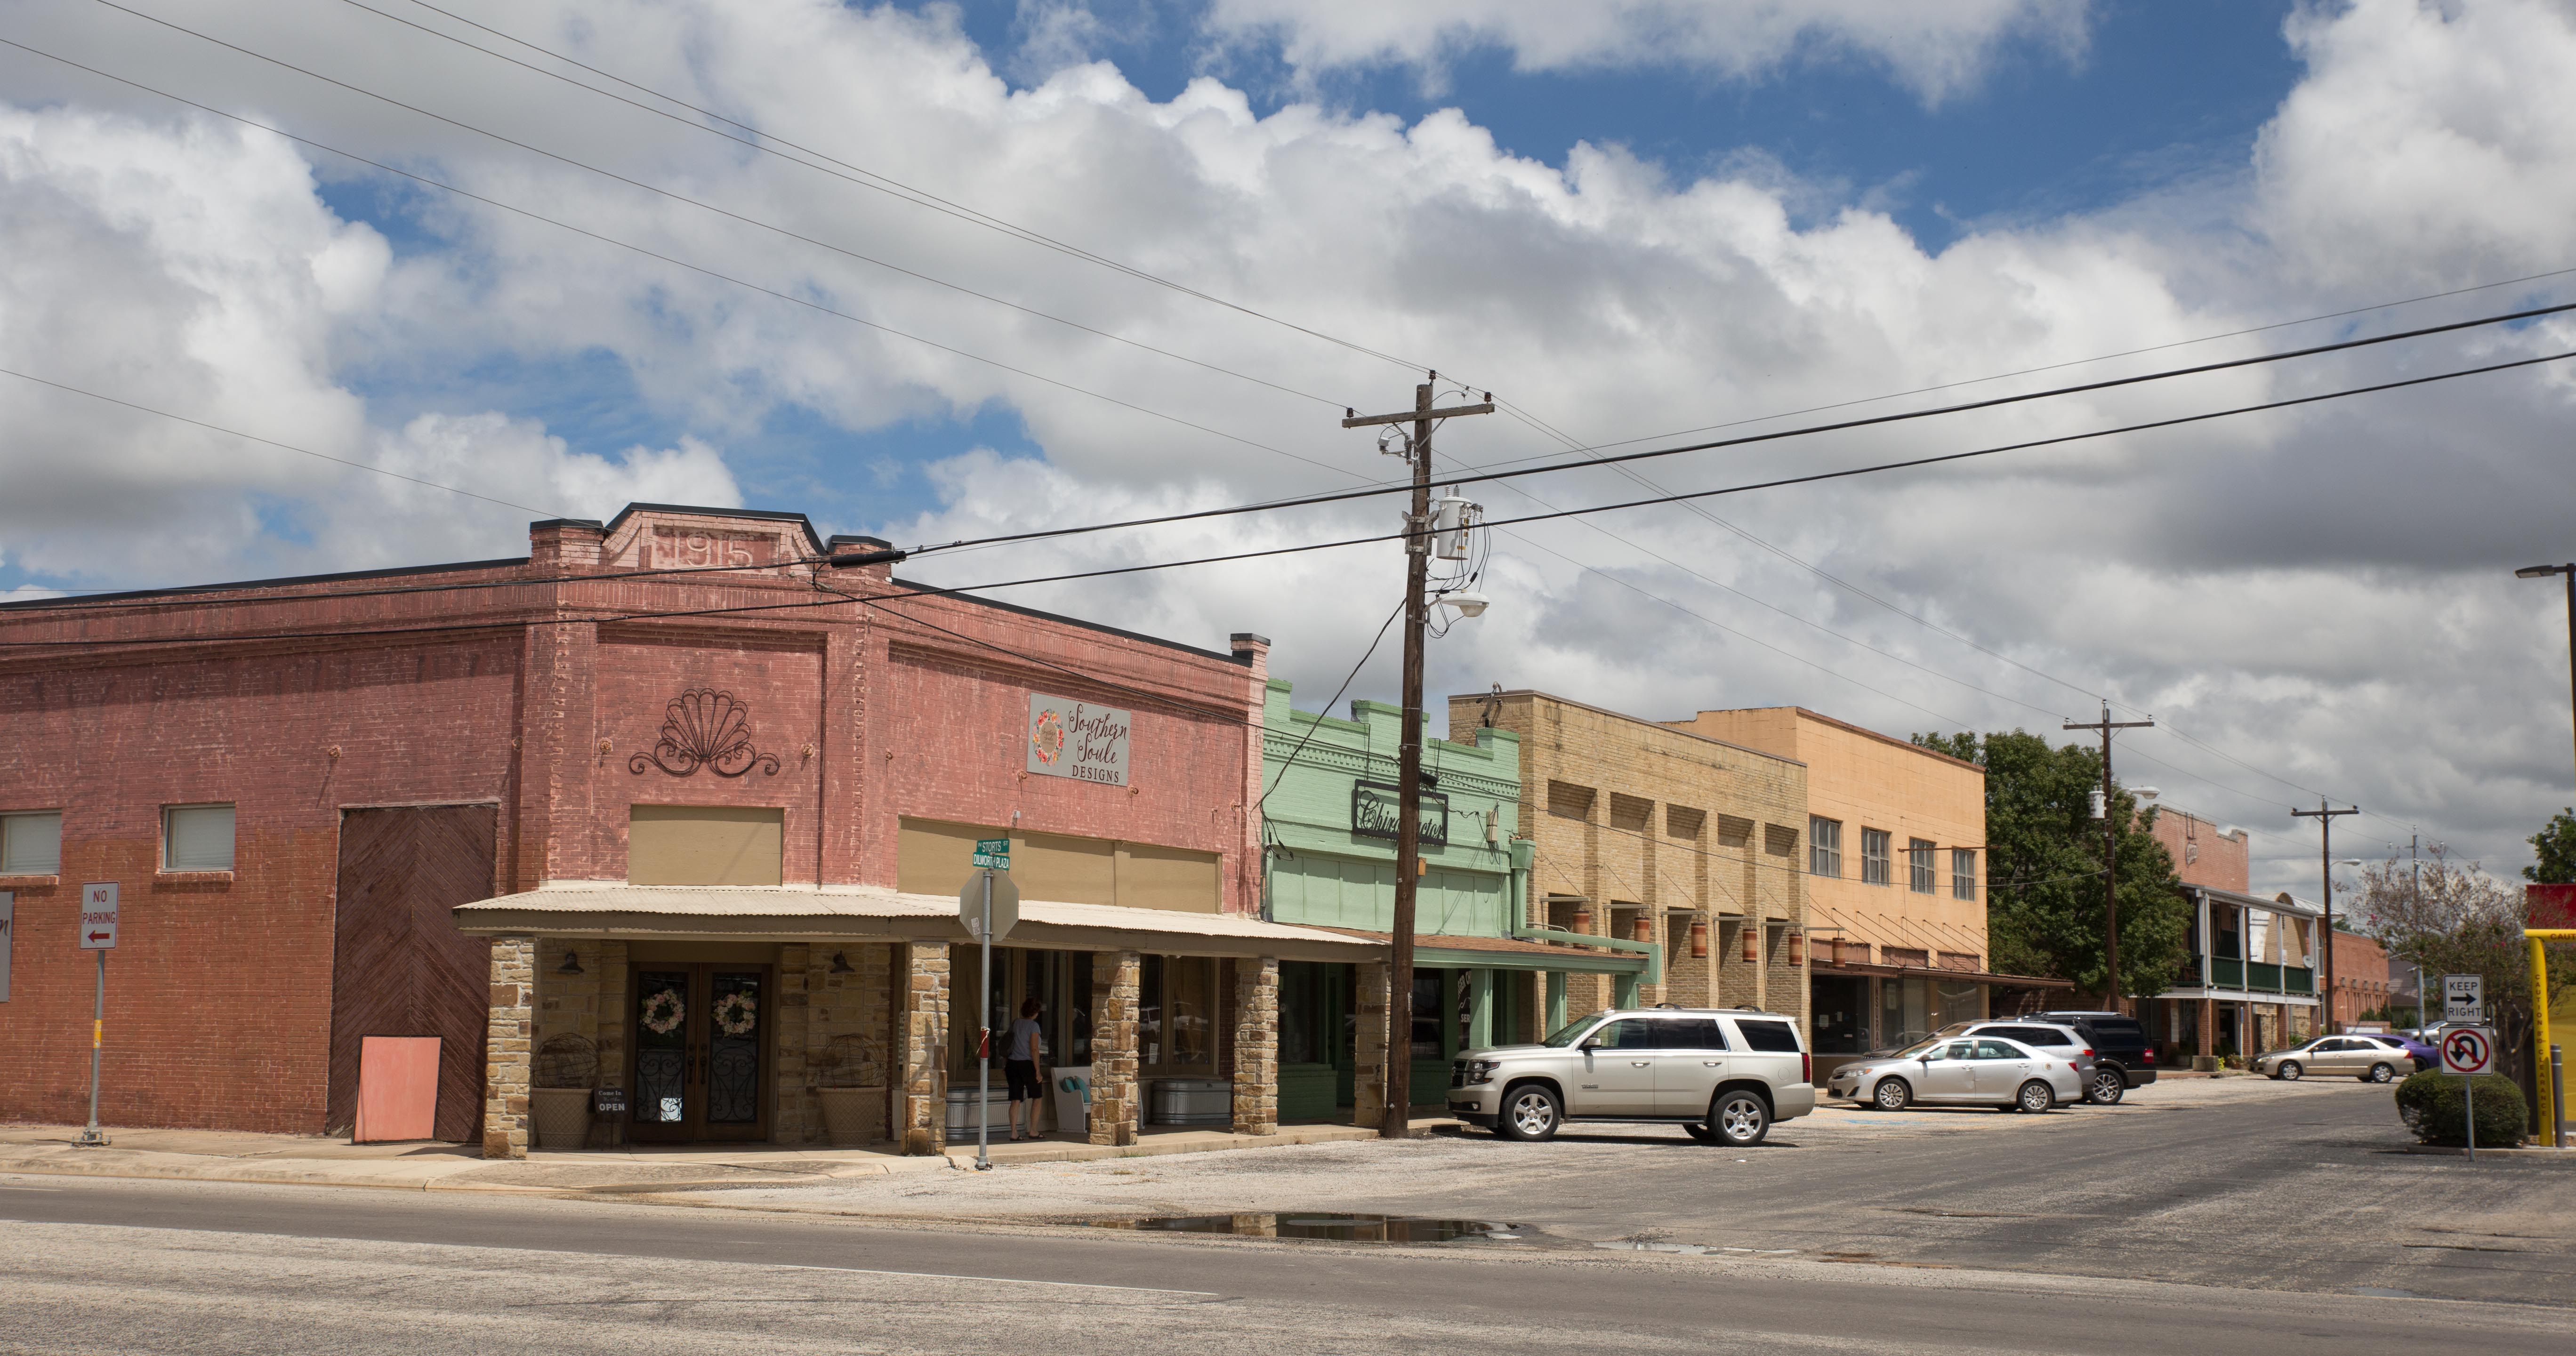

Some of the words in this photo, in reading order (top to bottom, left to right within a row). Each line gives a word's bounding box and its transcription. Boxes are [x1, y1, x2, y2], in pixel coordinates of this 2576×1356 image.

[674, 530, 753, 568] 1915
[1069, 704, 1127, 740] Southern
[1078, 733, 1118, 763] Soule
[1072, 765, 1119, 783] DESIGNS
[1360, 790, 1444, 841] Chiroctor
[982, 841, 1001, 852] STORTS
[974, 854, 996, 867] DILWORTH
[996, 857, 1009, 869] PLAZA
[93, 890, 107, 902] NO
[82, 911, 115, 924] PARKING
[2449, 982, 2478, 991] KEEP
[2535, 974, 2543, 1025] CAUTION
[2448, 1008, 2481, 1017] RIGHT
[2538, 1049, 2546, 1116] CLEARANCE
